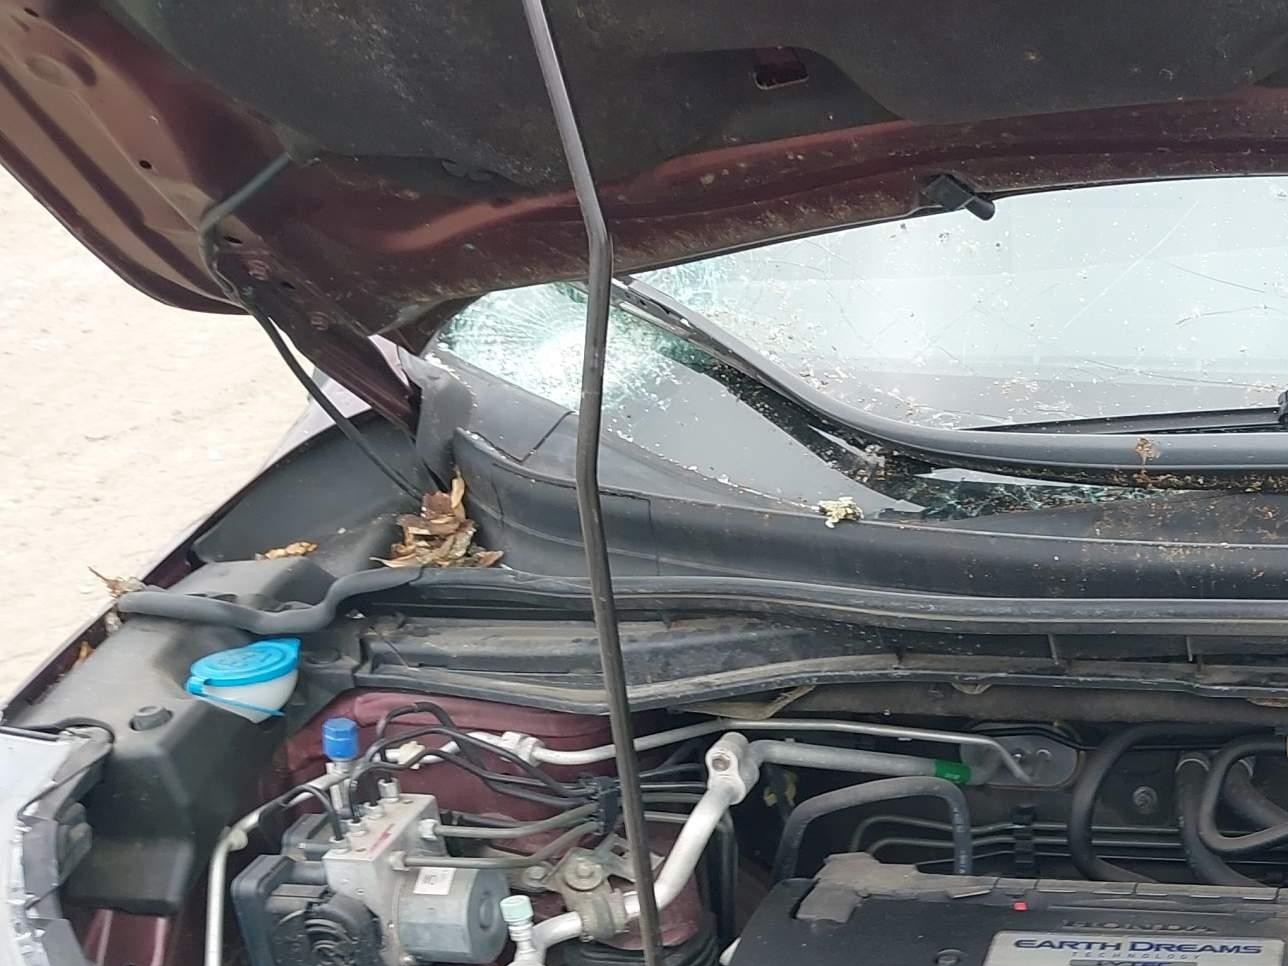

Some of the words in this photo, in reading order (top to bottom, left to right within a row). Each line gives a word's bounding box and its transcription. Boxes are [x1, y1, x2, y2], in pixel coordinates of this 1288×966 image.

[1061, 919, 1221, 935] HONDA
[1013, 938, 1122, 953] EARTH
[1128, 941, 1263, 955] DREAMS
